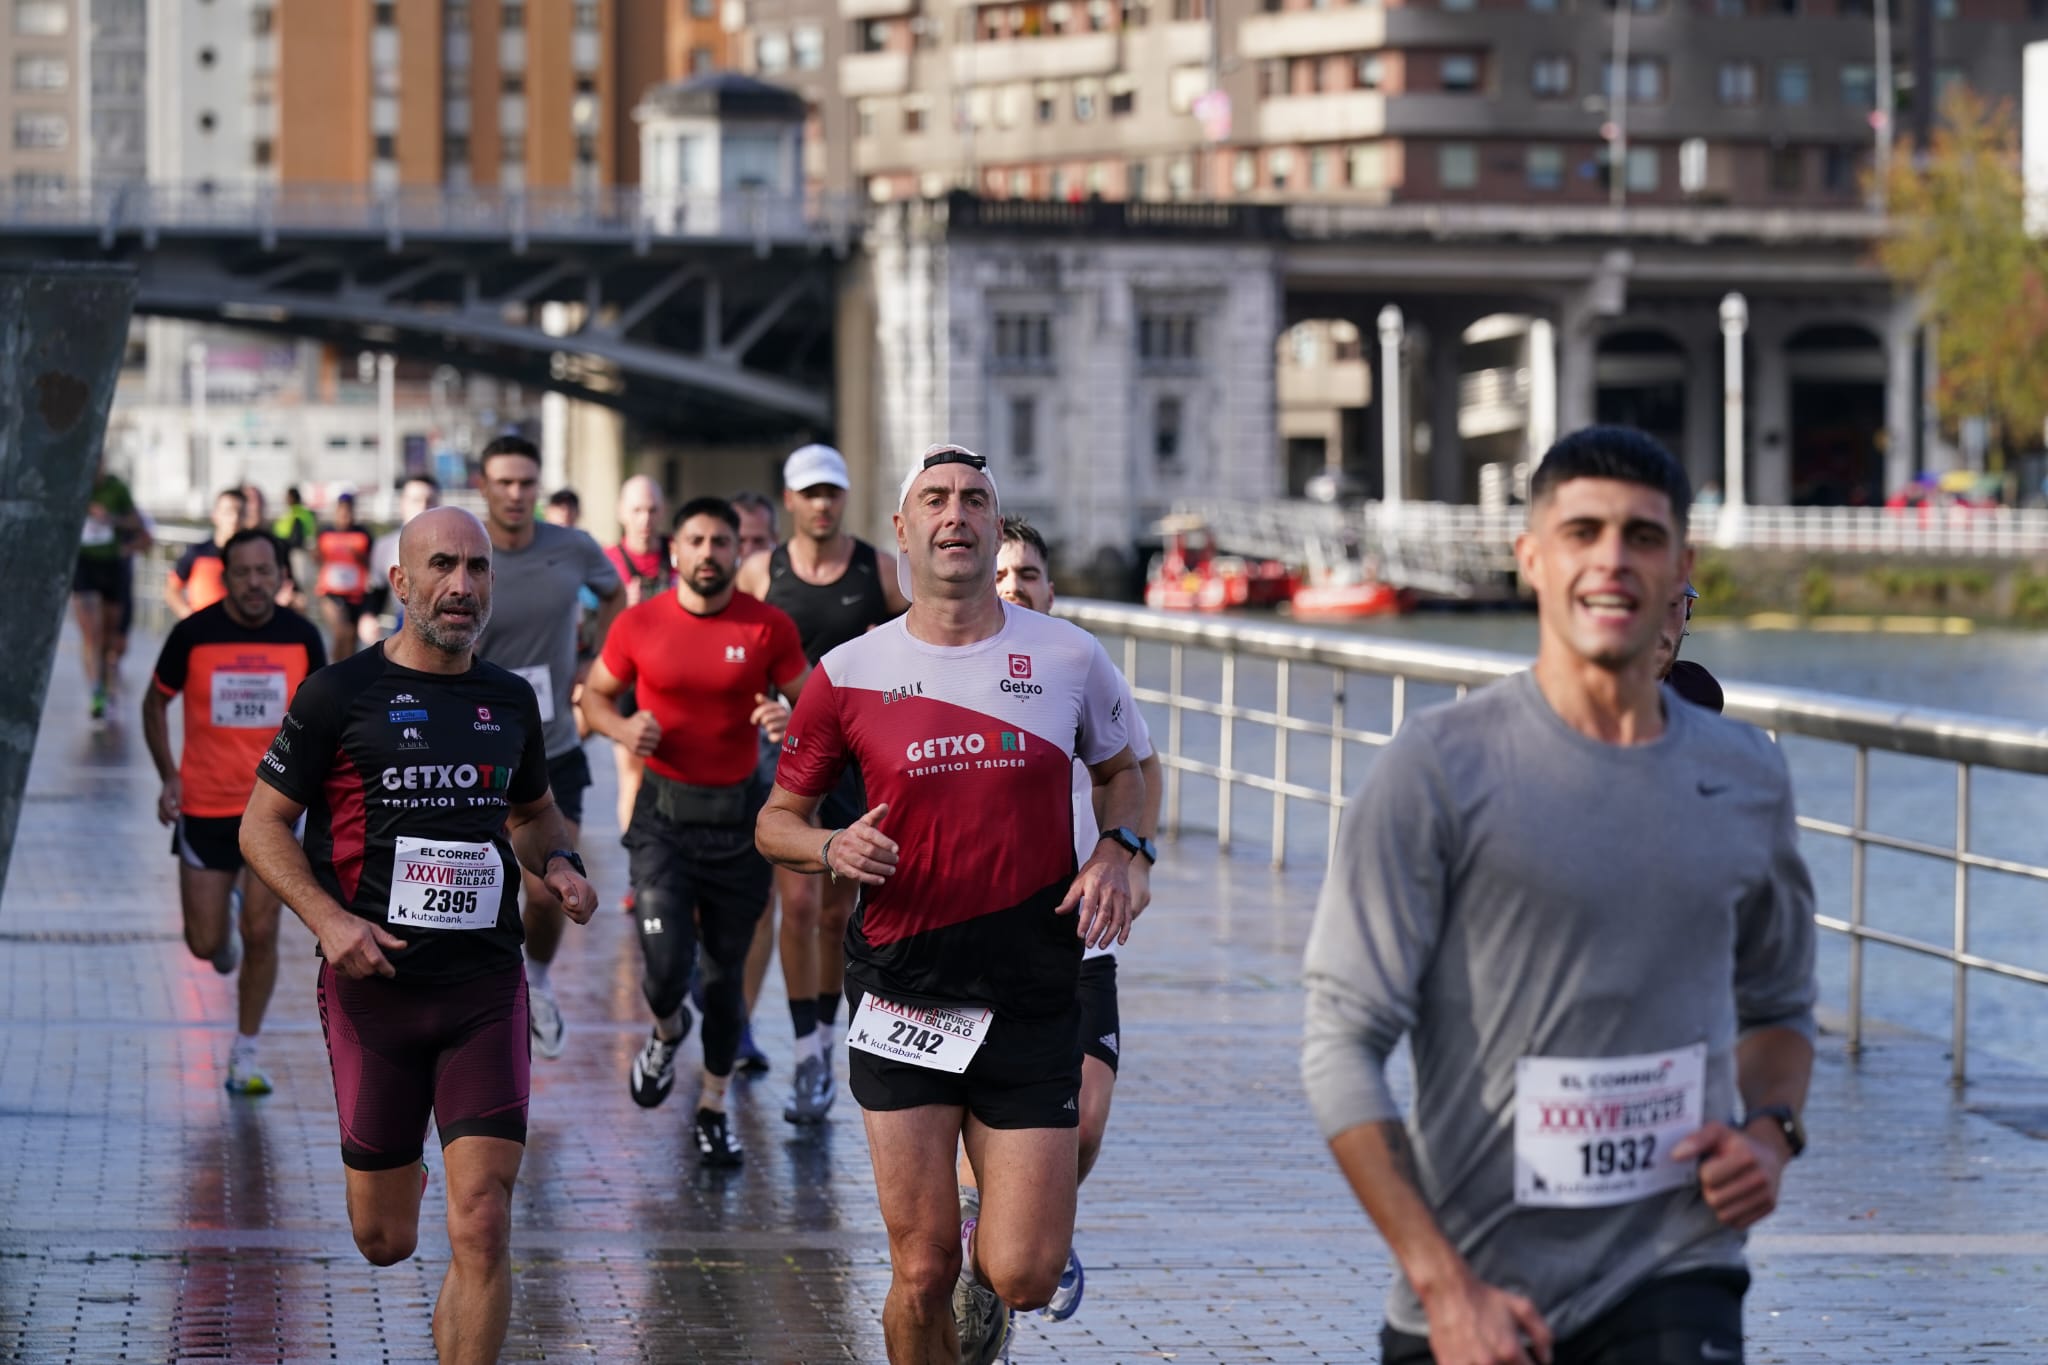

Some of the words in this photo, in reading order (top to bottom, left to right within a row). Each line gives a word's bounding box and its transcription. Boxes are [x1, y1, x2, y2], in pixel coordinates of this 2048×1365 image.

[883, 681, 924, 704] GOBIK
[1000, 679, 1043, 695] Getxo
[473, 721, 501, 732] Getxo
[907, 762, 970, 778] TRIATLOI
[975, 759, 1026, 770] TALDEA
[382, 797, 456, 808] TRIATLOI
[420, 847, 436, 858] EL
[437, 849, 486, 860] CORREO
[405, 863, 455, 885] XXXVII
[455, 876, 495, 886] BILBAO
[456, 868, 496, 877] SANTURCE
[422, 888, 478, 914] 2395
[411, 911, 462, 924] kutxabank
[924, 1014, 973, 1038] BILBAO
[927, 1007, 976, 1030] SANTURCE
[887, 1020, 945, 1055] 2742
[870, 1038, 923, 1060] kutxabank
[1578, 1132, 1656, 1176] 1932
